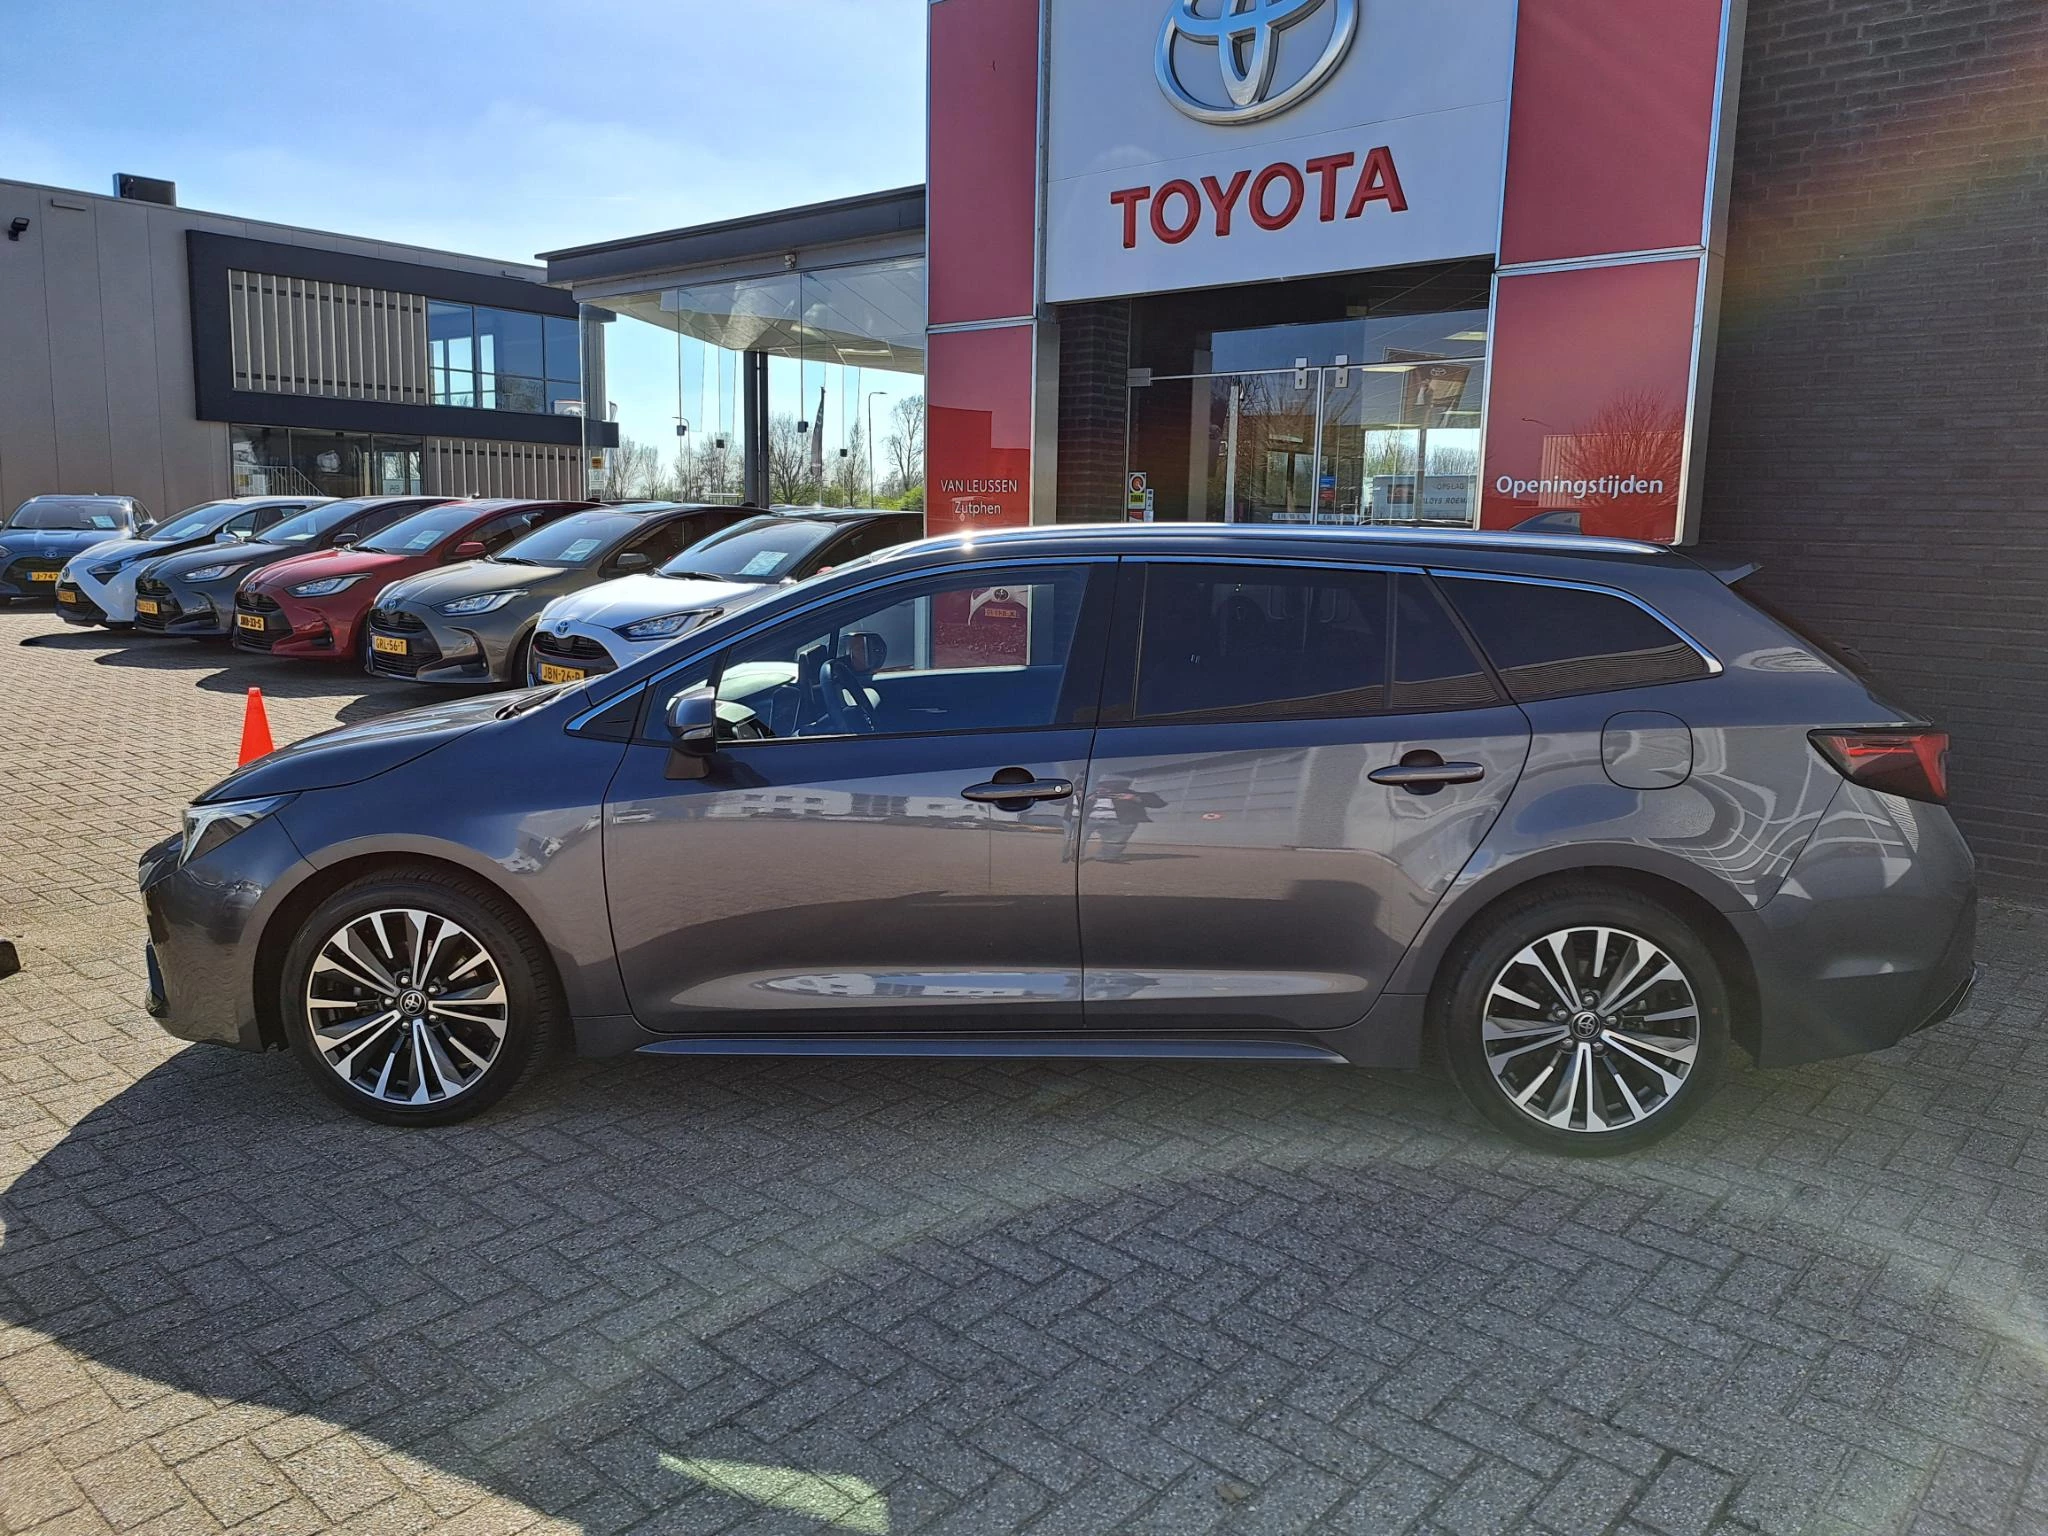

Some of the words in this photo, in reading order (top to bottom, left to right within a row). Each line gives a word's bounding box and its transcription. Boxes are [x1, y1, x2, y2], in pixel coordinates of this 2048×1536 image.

[1110, 145, 1408, 249] TOYOTA
[940, 479, 964, 493] VAN
[966, 479, 1018, 493] LEUSSEN
[1496, 475, 1664, 499] Openingstijden
[954, 501, 1001, 517] Zutphen
[375, 637, 405, 653] GRL-56-T
